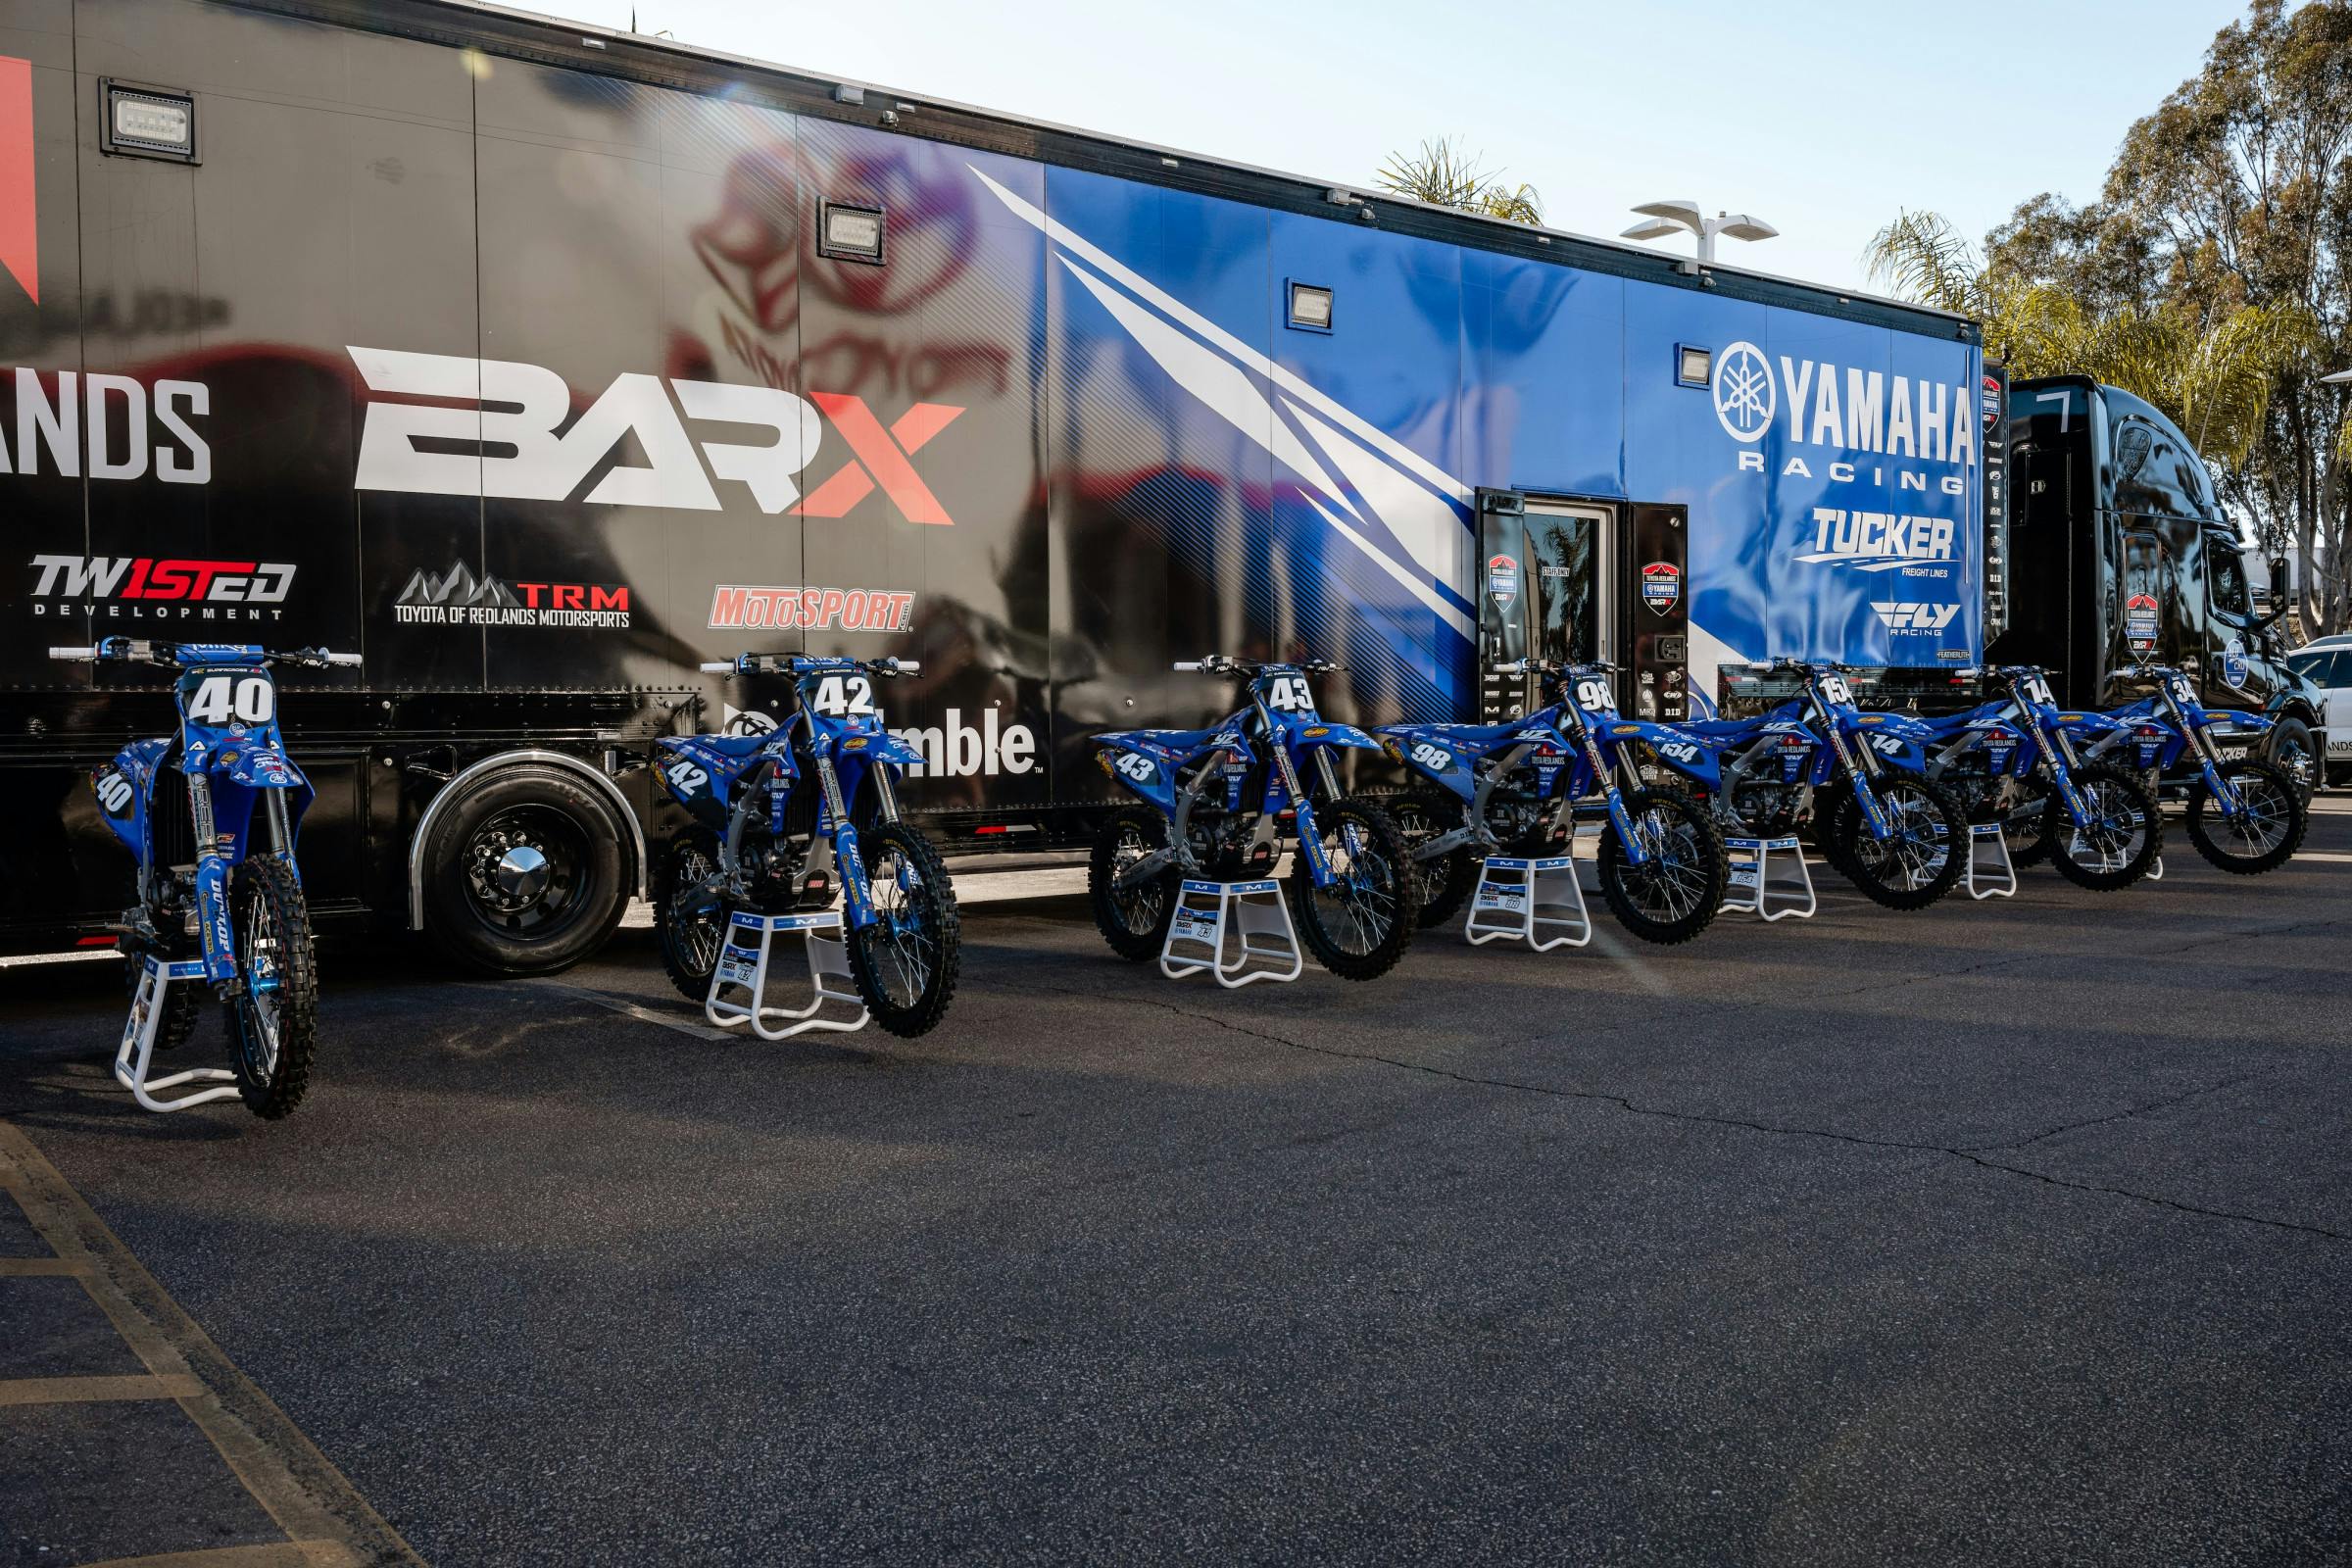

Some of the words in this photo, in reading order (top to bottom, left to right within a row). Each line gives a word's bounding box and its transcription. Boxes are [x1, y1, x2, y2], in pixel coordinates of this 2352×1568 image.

[1780, 356, 1976, 466] YAMAHA
[345, 345, 966, 525] BARX
[1739, 451, 1964, 495] RACING
[1813, 508, 1954, 560] TUCKER
[1902, 567, 1929, 577] FREIGHT
[1930, 569, 1948, 578] LINES
[516, 583, 628, 611] TRM
[1653, 584, 1675, 593] YAMAHA
[34, 604, 282, 620] DEVELOPMENT
[395, 606, 445, 623] TOYOTA
[450, 608, 466, 624] OF
[469, 608, 536, 626] REDLANDS
[539, 611, 630, 628] MOTORSPORTS
[1870, 602, 1960, 627] FLY
[2133, 640, 2152, 649] BARX
[189, 676, 272, 723] 40
[813, 676, 874, 714] 42
[1270, 678, 1314, 710] 43
[1578, 681, 1615, 710] 98
[2024, 679, 2055, 704] 14
[1411, 743, 1451, 769] 98
[1660, 743, 1698, 762] 154
[1873, 734, 1904, 755] 14
[667, 761, 708, 796] 42
[1115, 752, 1155, 781] 43
[97, 772, 132, 811] 40
[1198, 928, 1212, 938] 43
[738, 969, 752, 981] 42
